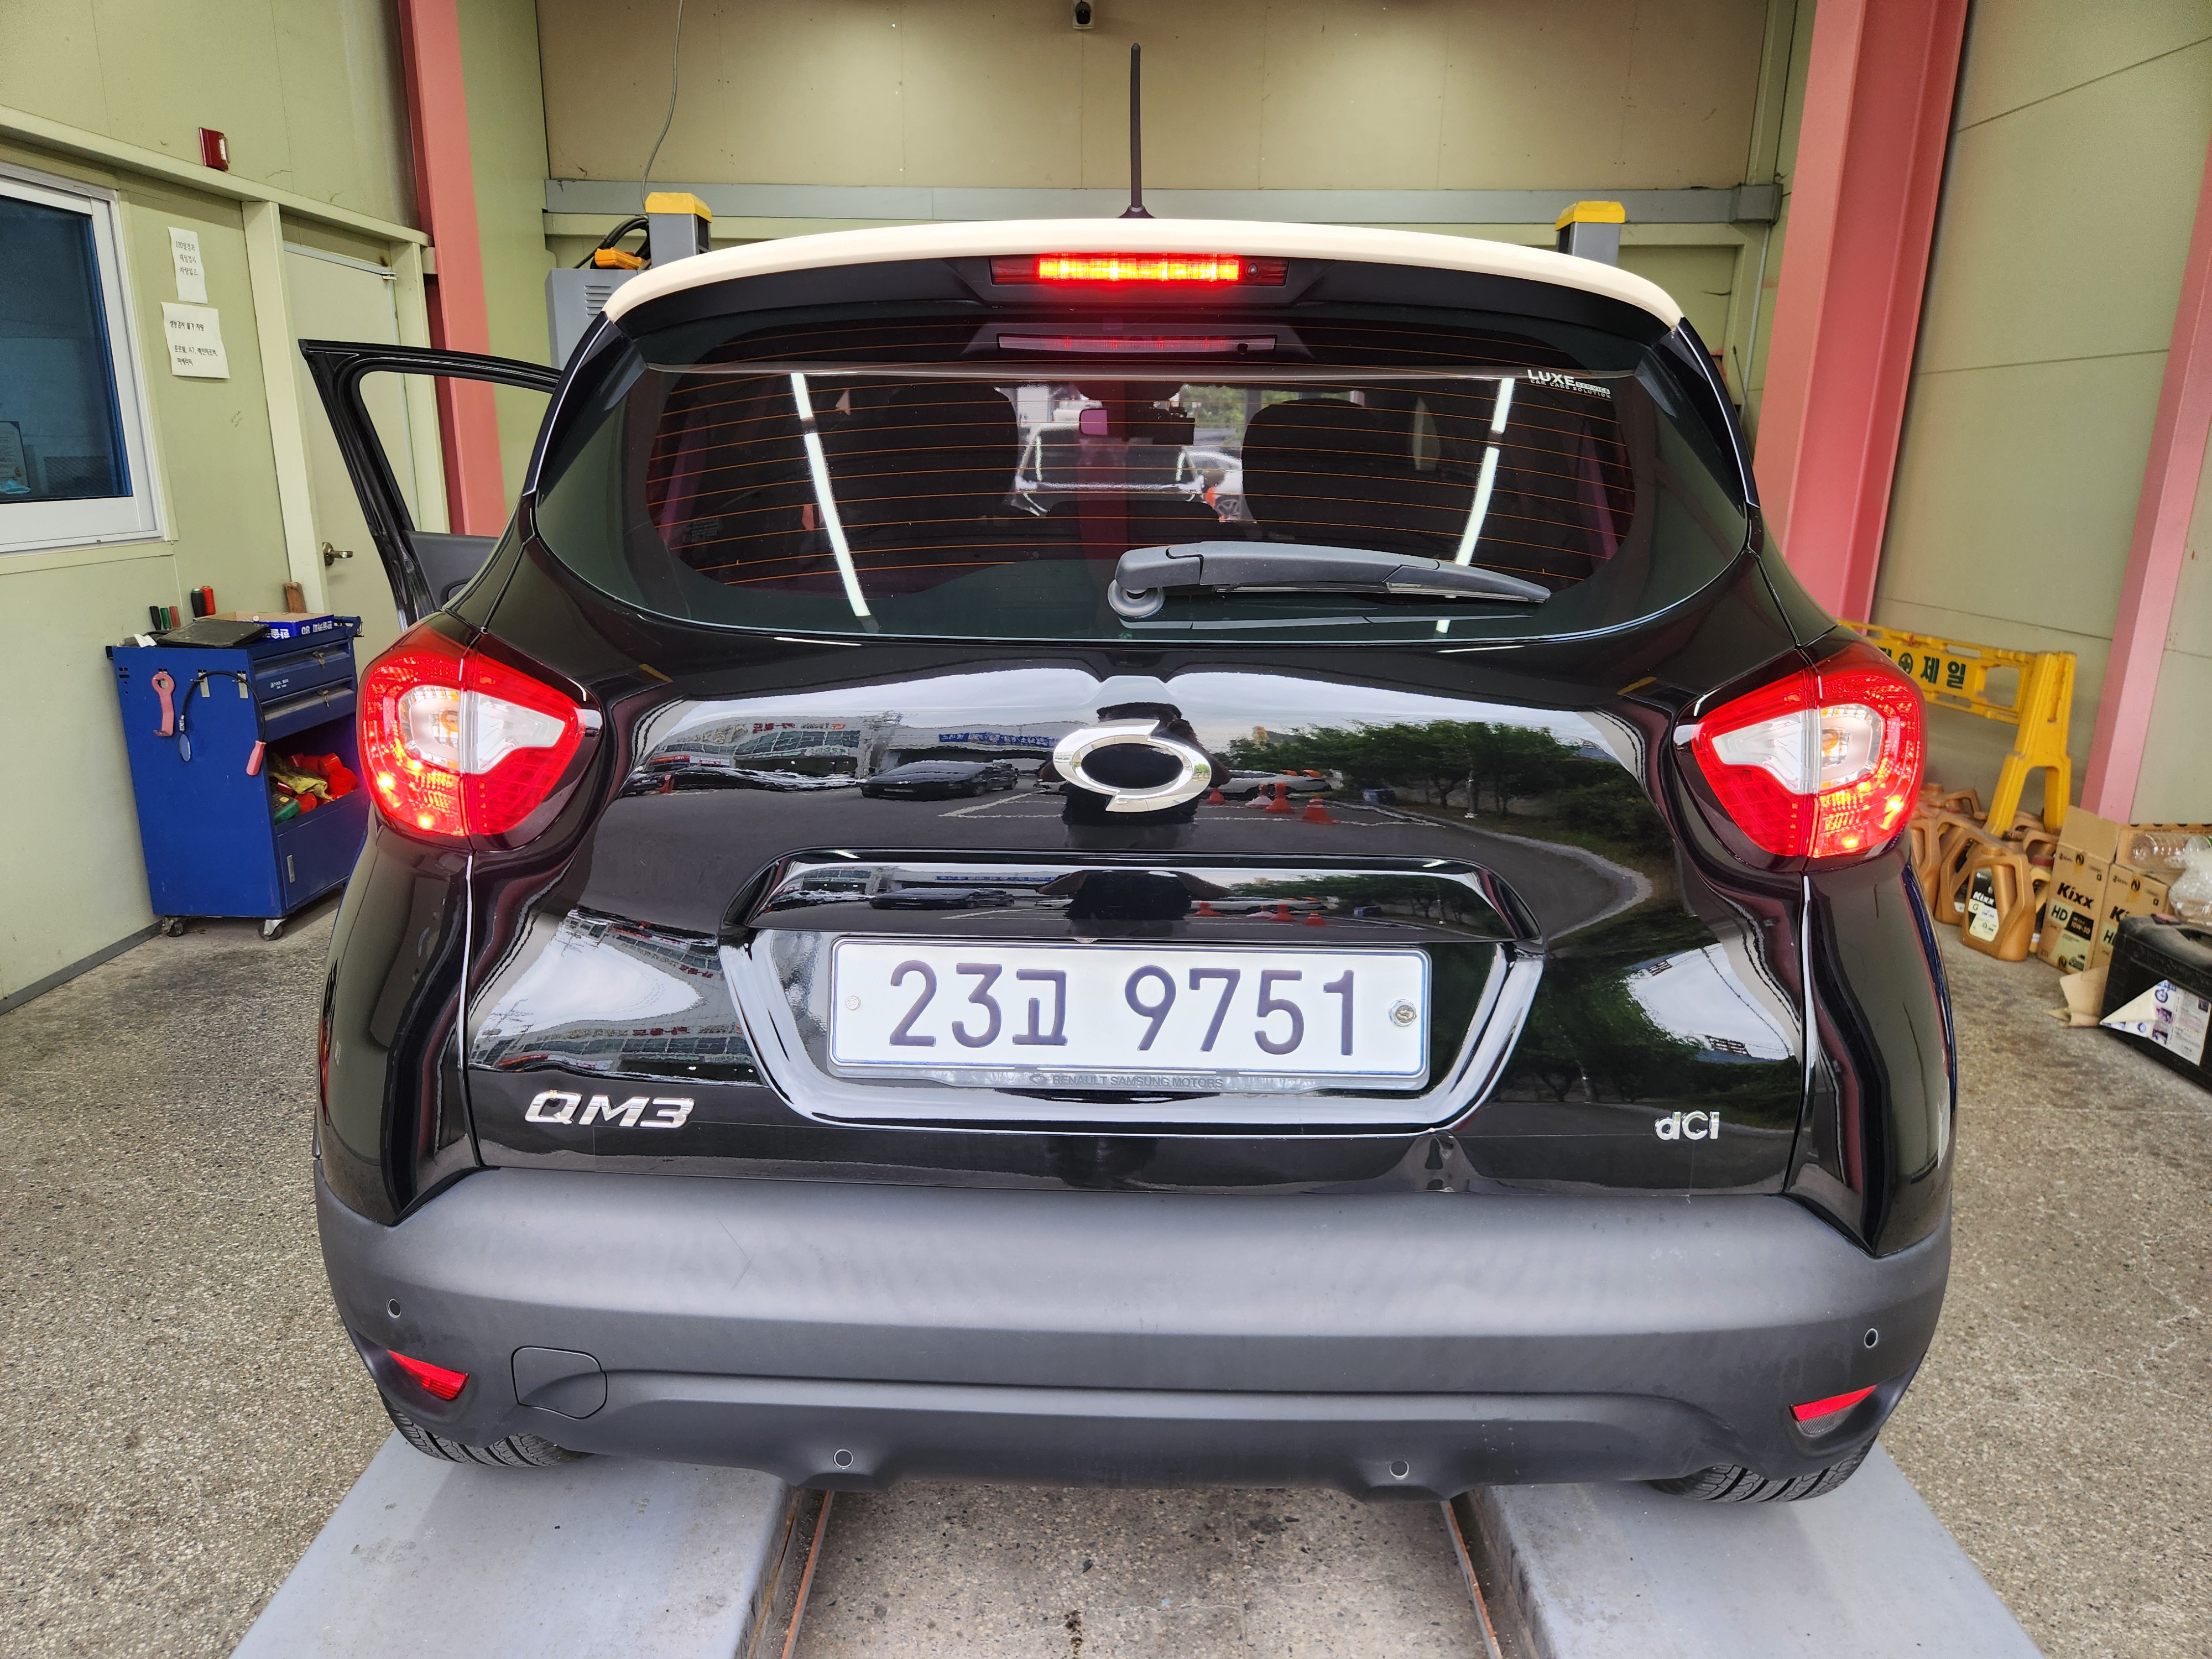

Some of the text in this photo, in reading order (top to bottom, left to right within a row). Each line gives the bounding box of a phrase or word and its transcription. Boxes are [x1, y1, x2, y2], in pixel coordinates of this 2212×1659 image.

[1527, 369, 1610, 394] LUXE SERVICE
[1550, 382, 1571, 390] CARE
[1572, 387, 1612, 399] SOLUTION
[301, 625, 311, 635] 80
[2057, 881, 2094, 910] Kixx
[2051, 905, 2068, 921] HD
[889, 959, 1355, 1056] 23고 9751
[1052, 1075, 1223, 1088] RENAULT SAMSUNG MOTORS
[525, 1089, 695, 1128] QM3
